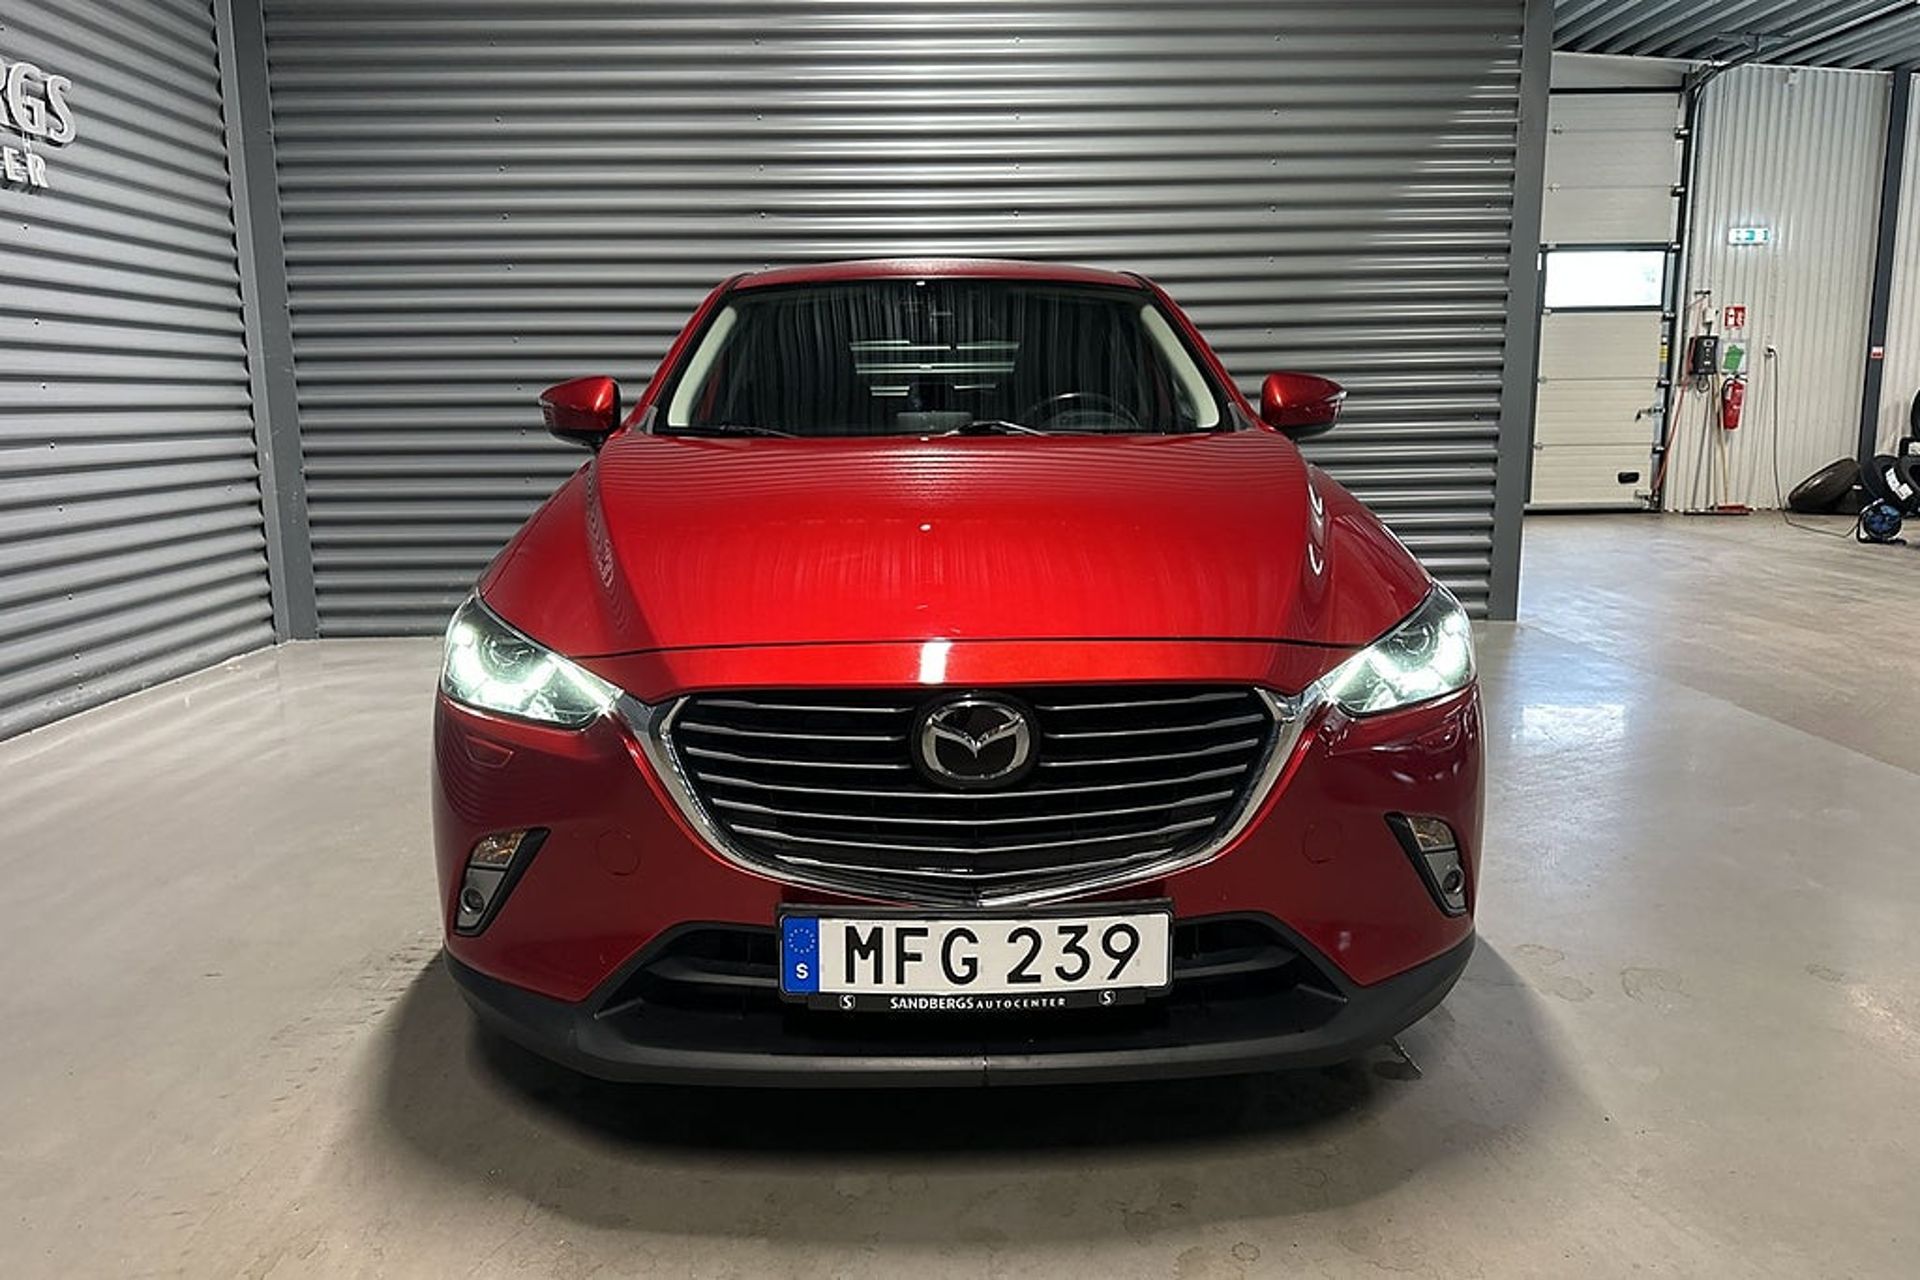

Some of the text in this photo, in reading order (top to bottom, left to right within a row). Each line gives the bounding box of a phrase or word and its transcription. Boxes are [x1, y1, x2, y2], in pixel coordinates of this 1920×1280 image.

[845, 923, 1140, 985] MFG 239
[796, 963, 809, 979] S
[890, 996, 1066, 1010] SANDBERGS AUTOCENTER
